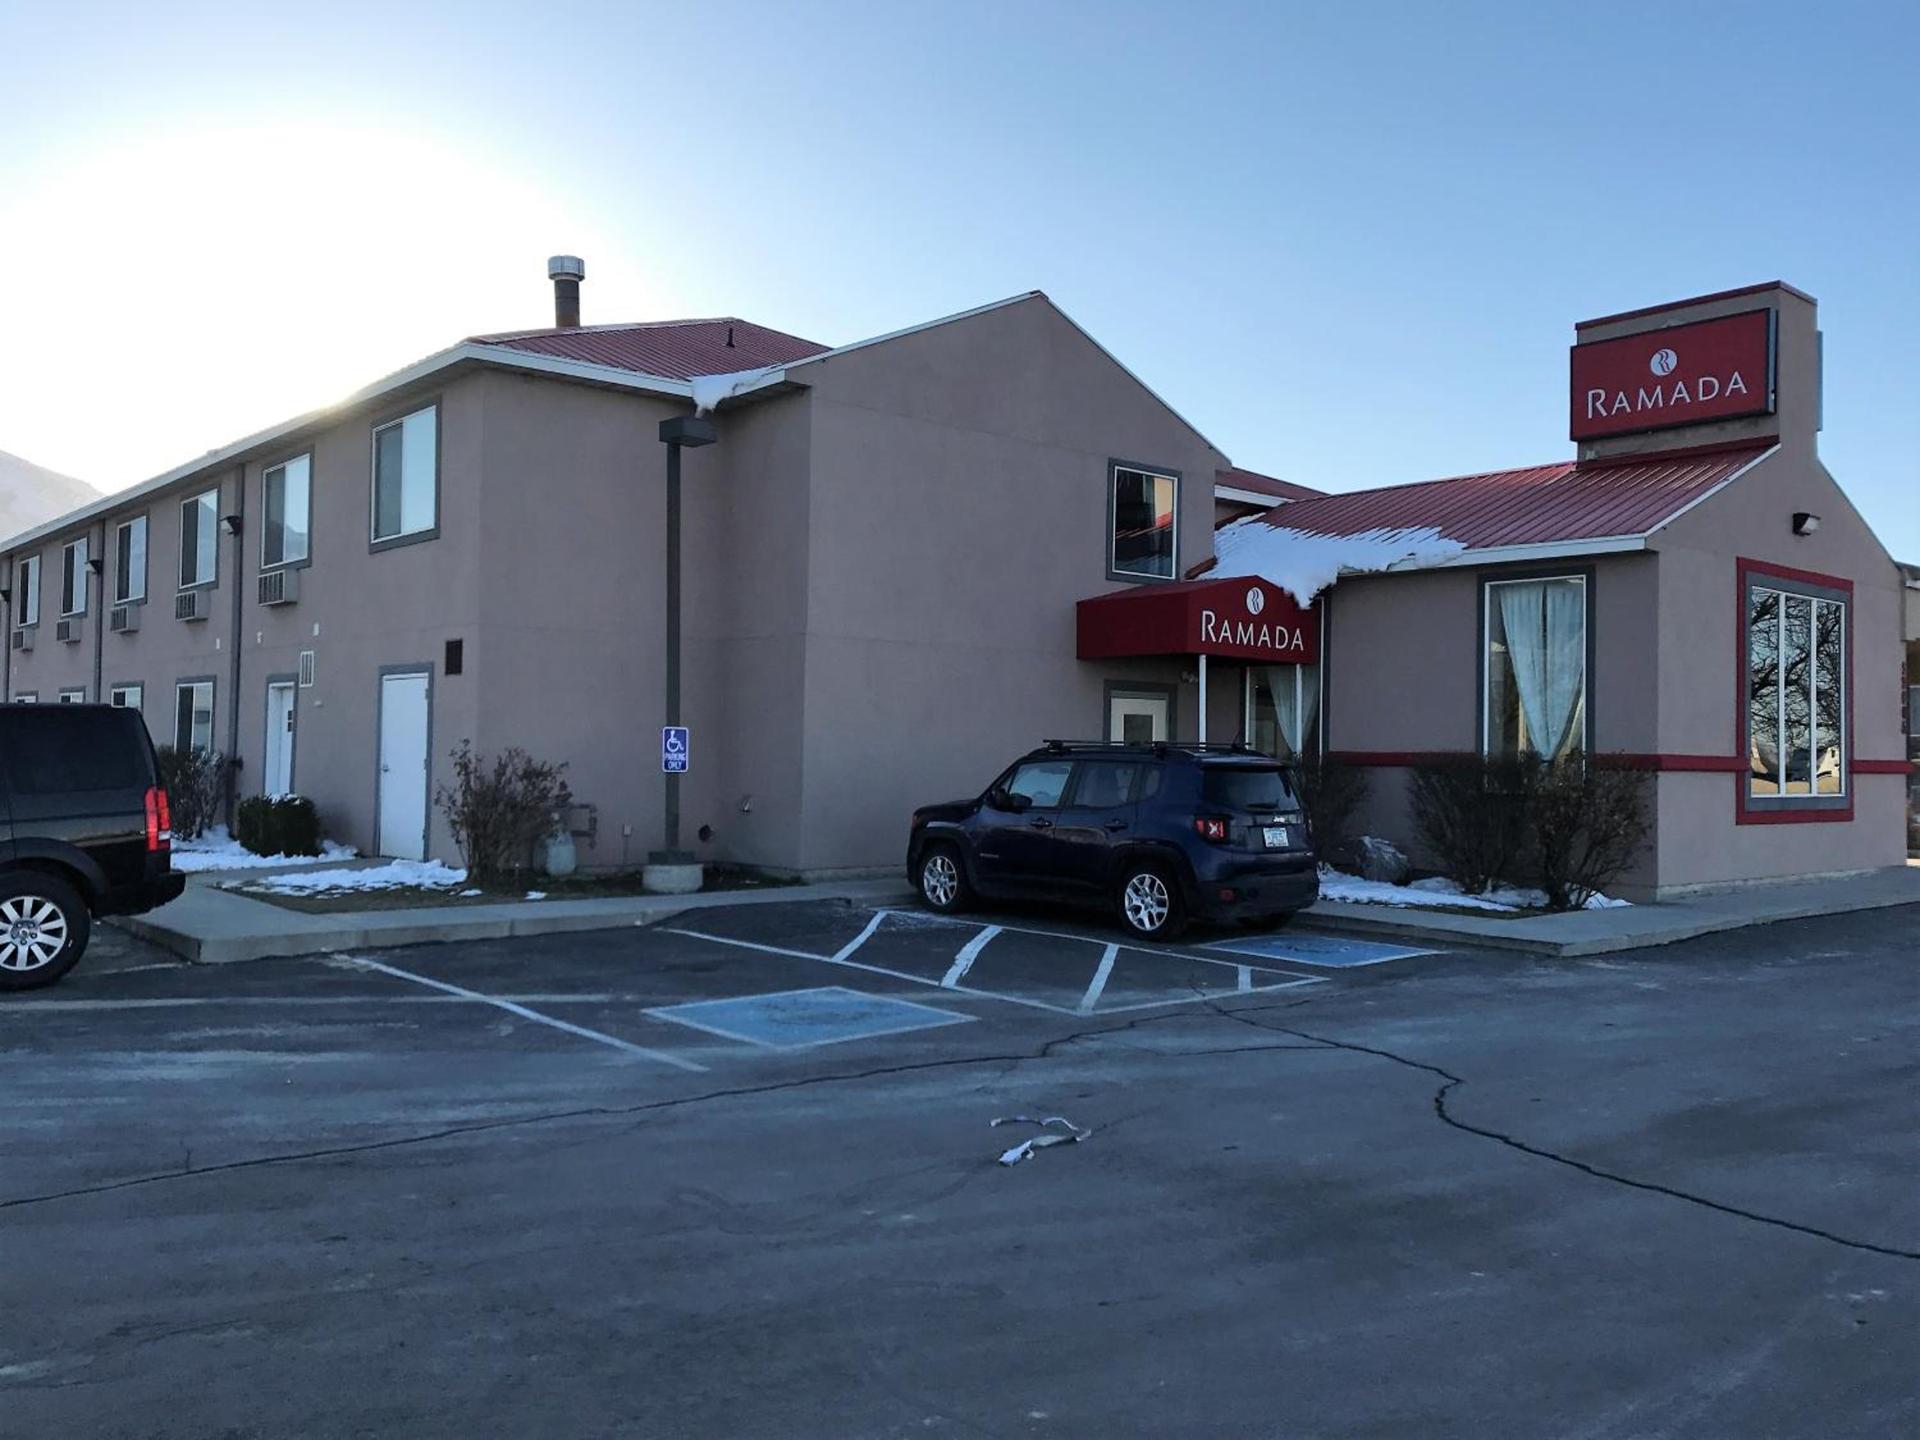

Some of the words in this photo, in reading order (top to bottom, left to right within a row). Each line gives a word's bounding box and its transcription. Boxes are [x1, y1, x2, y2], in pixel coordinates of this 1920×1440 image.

[1587, 371, 1748, 419] RAMADA
[1201, 610, 1304, 651] RAMADA
[668, 761, 682, 770] ONLY
